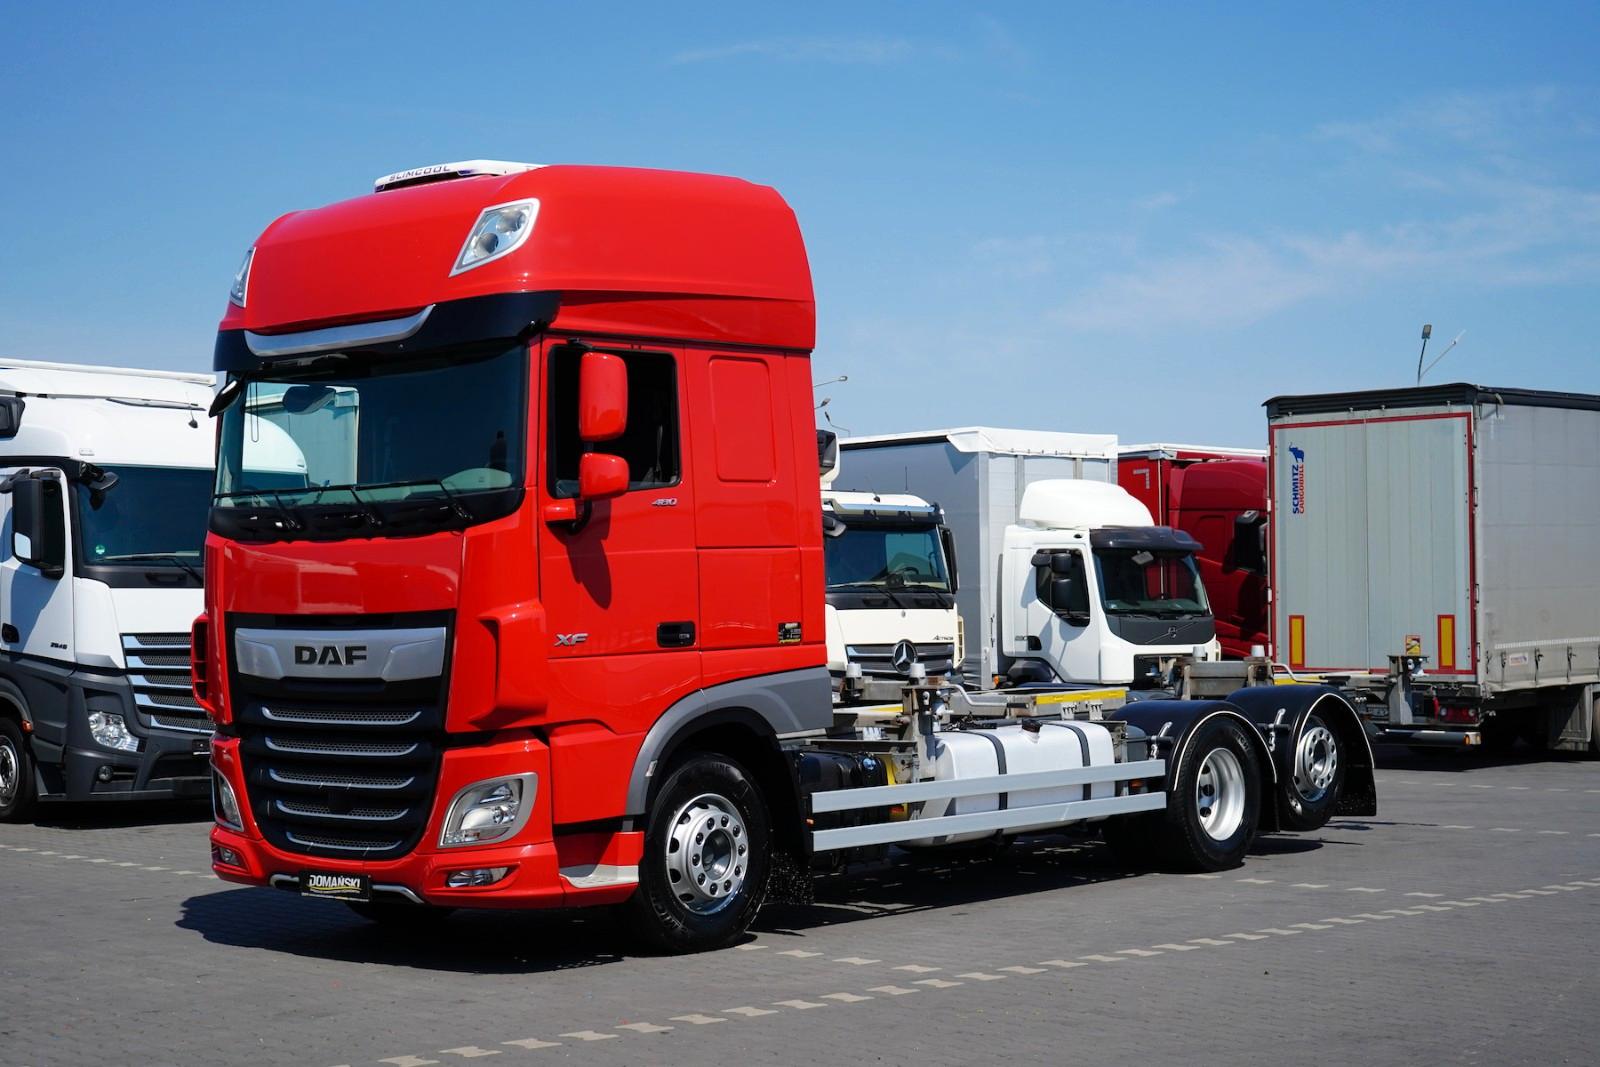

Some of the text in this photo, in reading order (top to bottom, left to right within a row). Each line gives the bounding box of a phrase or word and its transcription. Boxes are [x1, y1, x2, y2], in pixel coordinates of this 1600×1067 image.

[389, 165, 450, 181] SLIMCOOL
[651, 498, 677, 506] 480
[554, 633, 588, 646] XF
[294, 645, 367, 665] DAF
[308, 874, 361, 888] DOMAŃSKI
